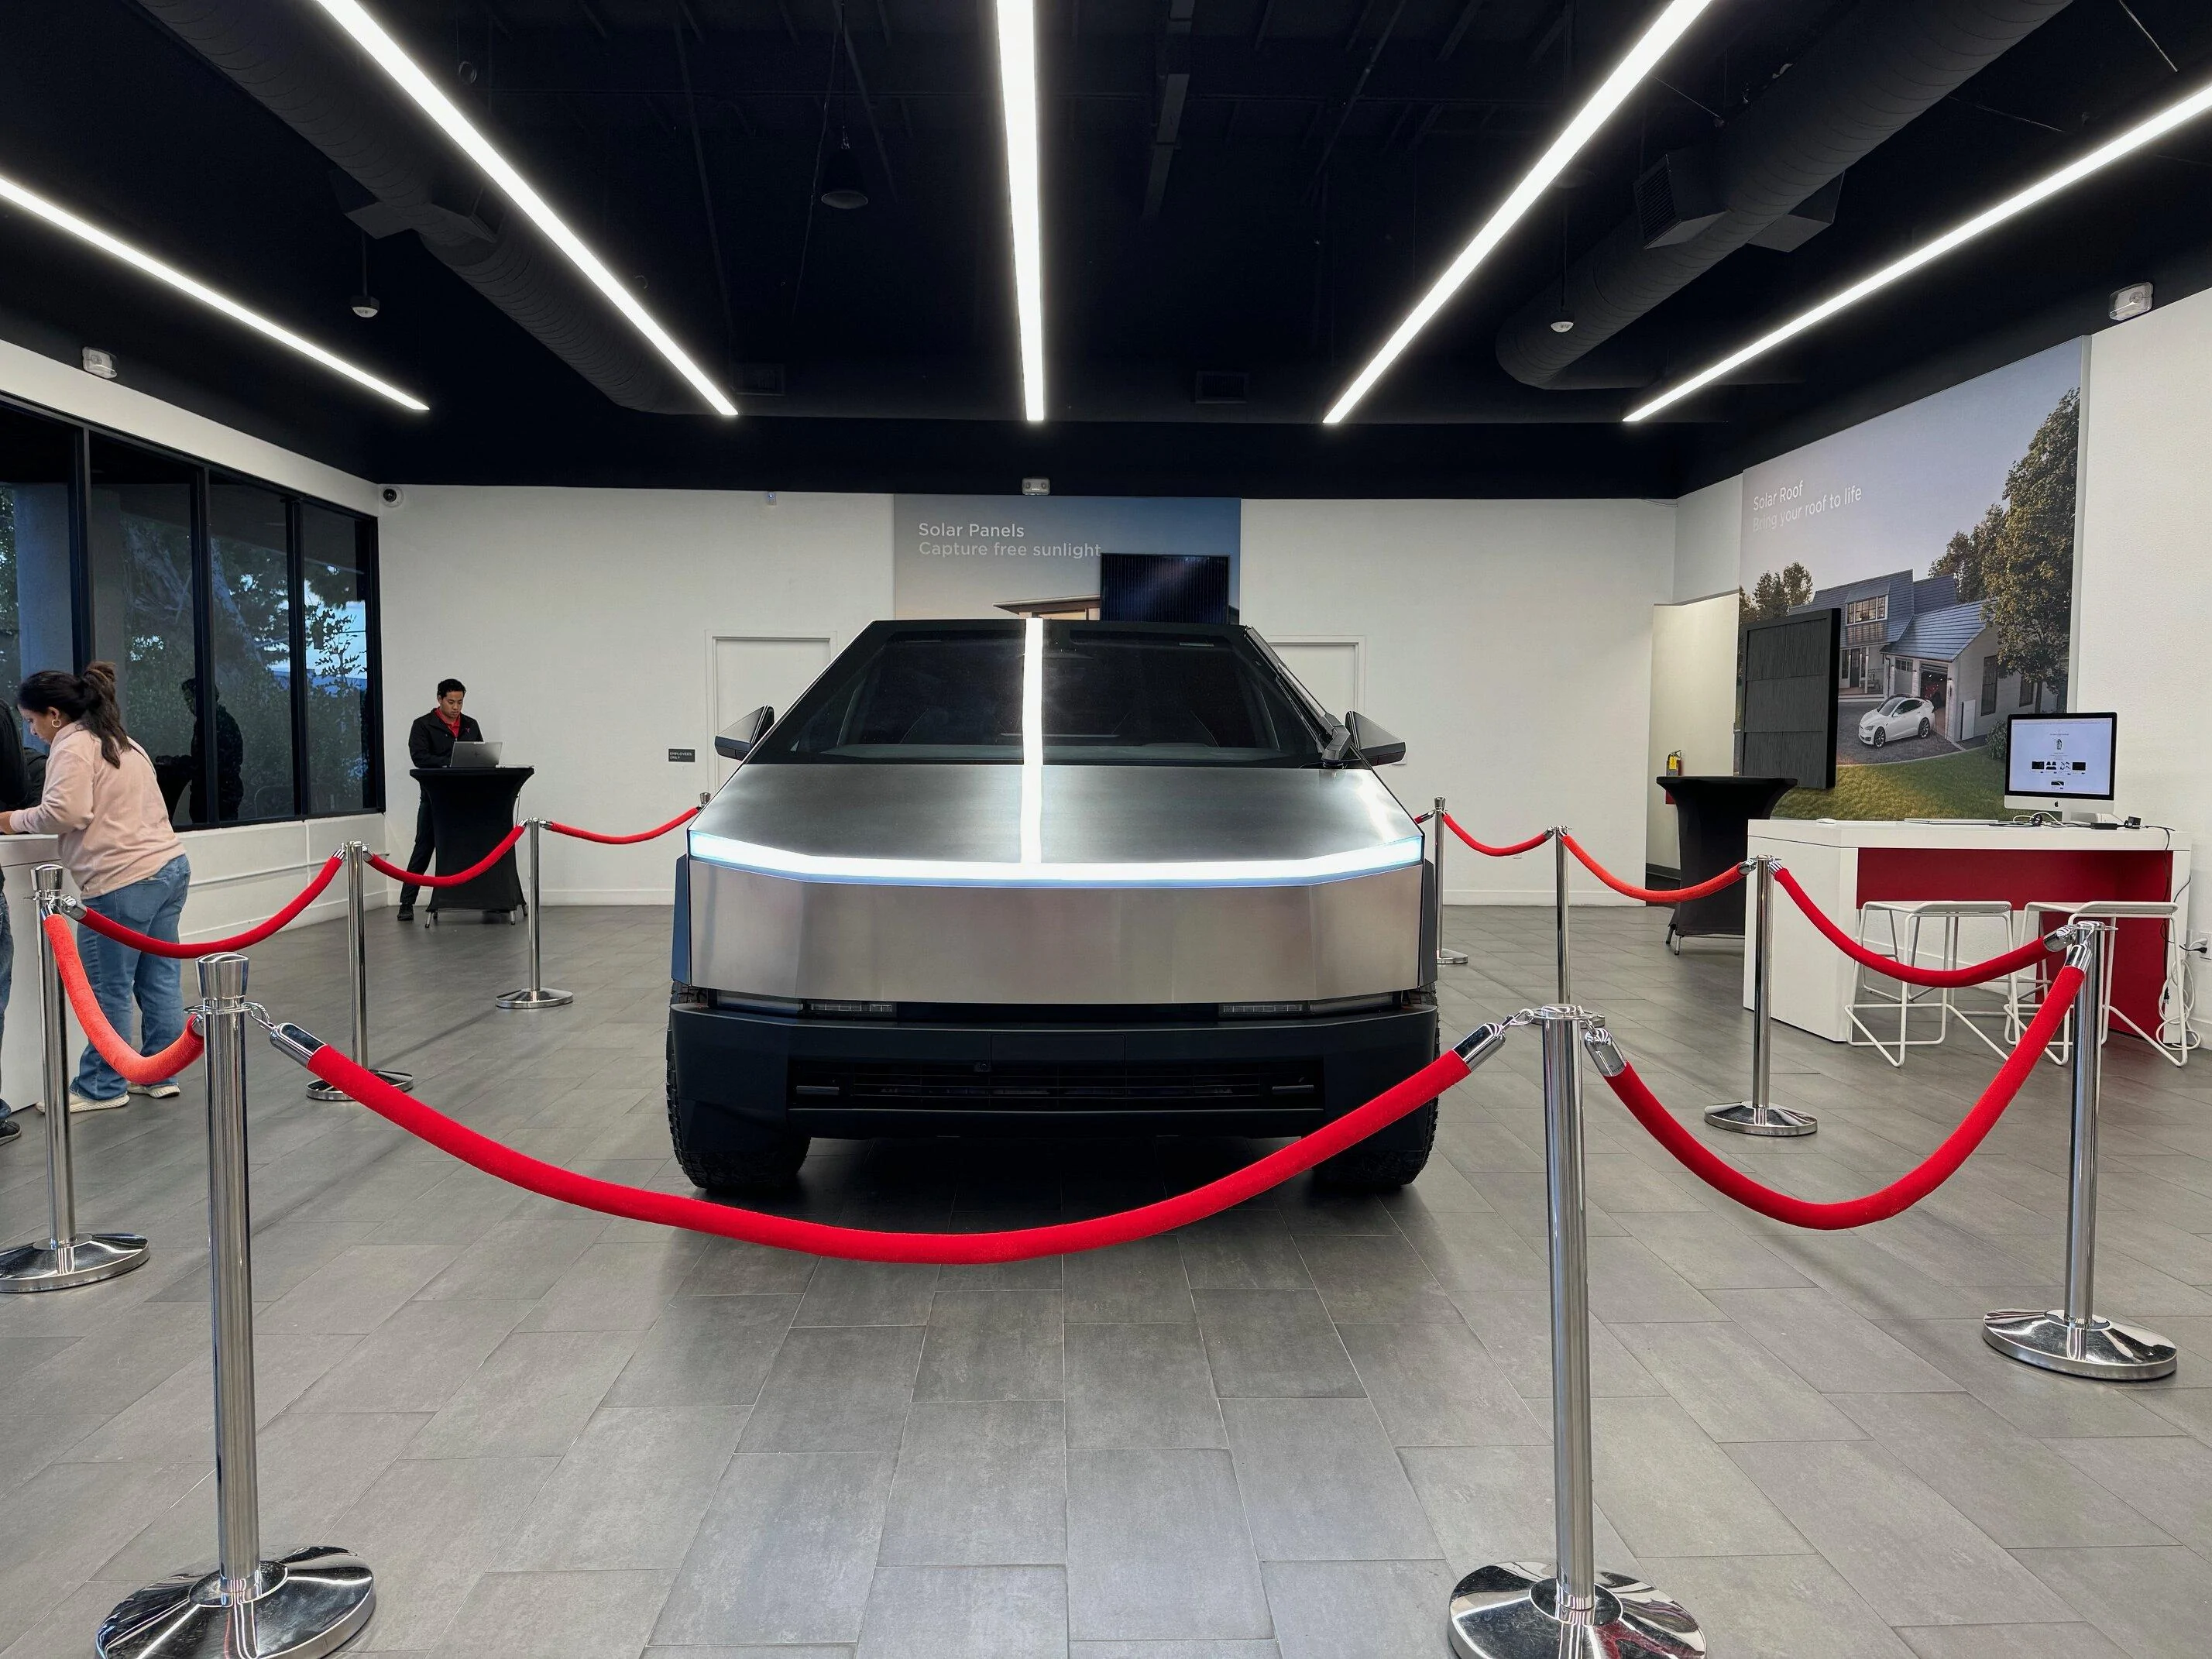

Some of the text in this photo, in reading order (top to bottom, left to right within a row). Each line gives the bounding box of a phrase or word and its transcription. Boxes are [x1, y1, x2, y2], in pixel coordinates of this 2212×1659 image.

[1753, 480, 1803, 511] Solar Roof
[1753, 485, 1862, 532] Bring your roof to life
[919, 522, 1025, 537] Solar Panels
[919, 541, 1101, 558] Capture free sunlight
